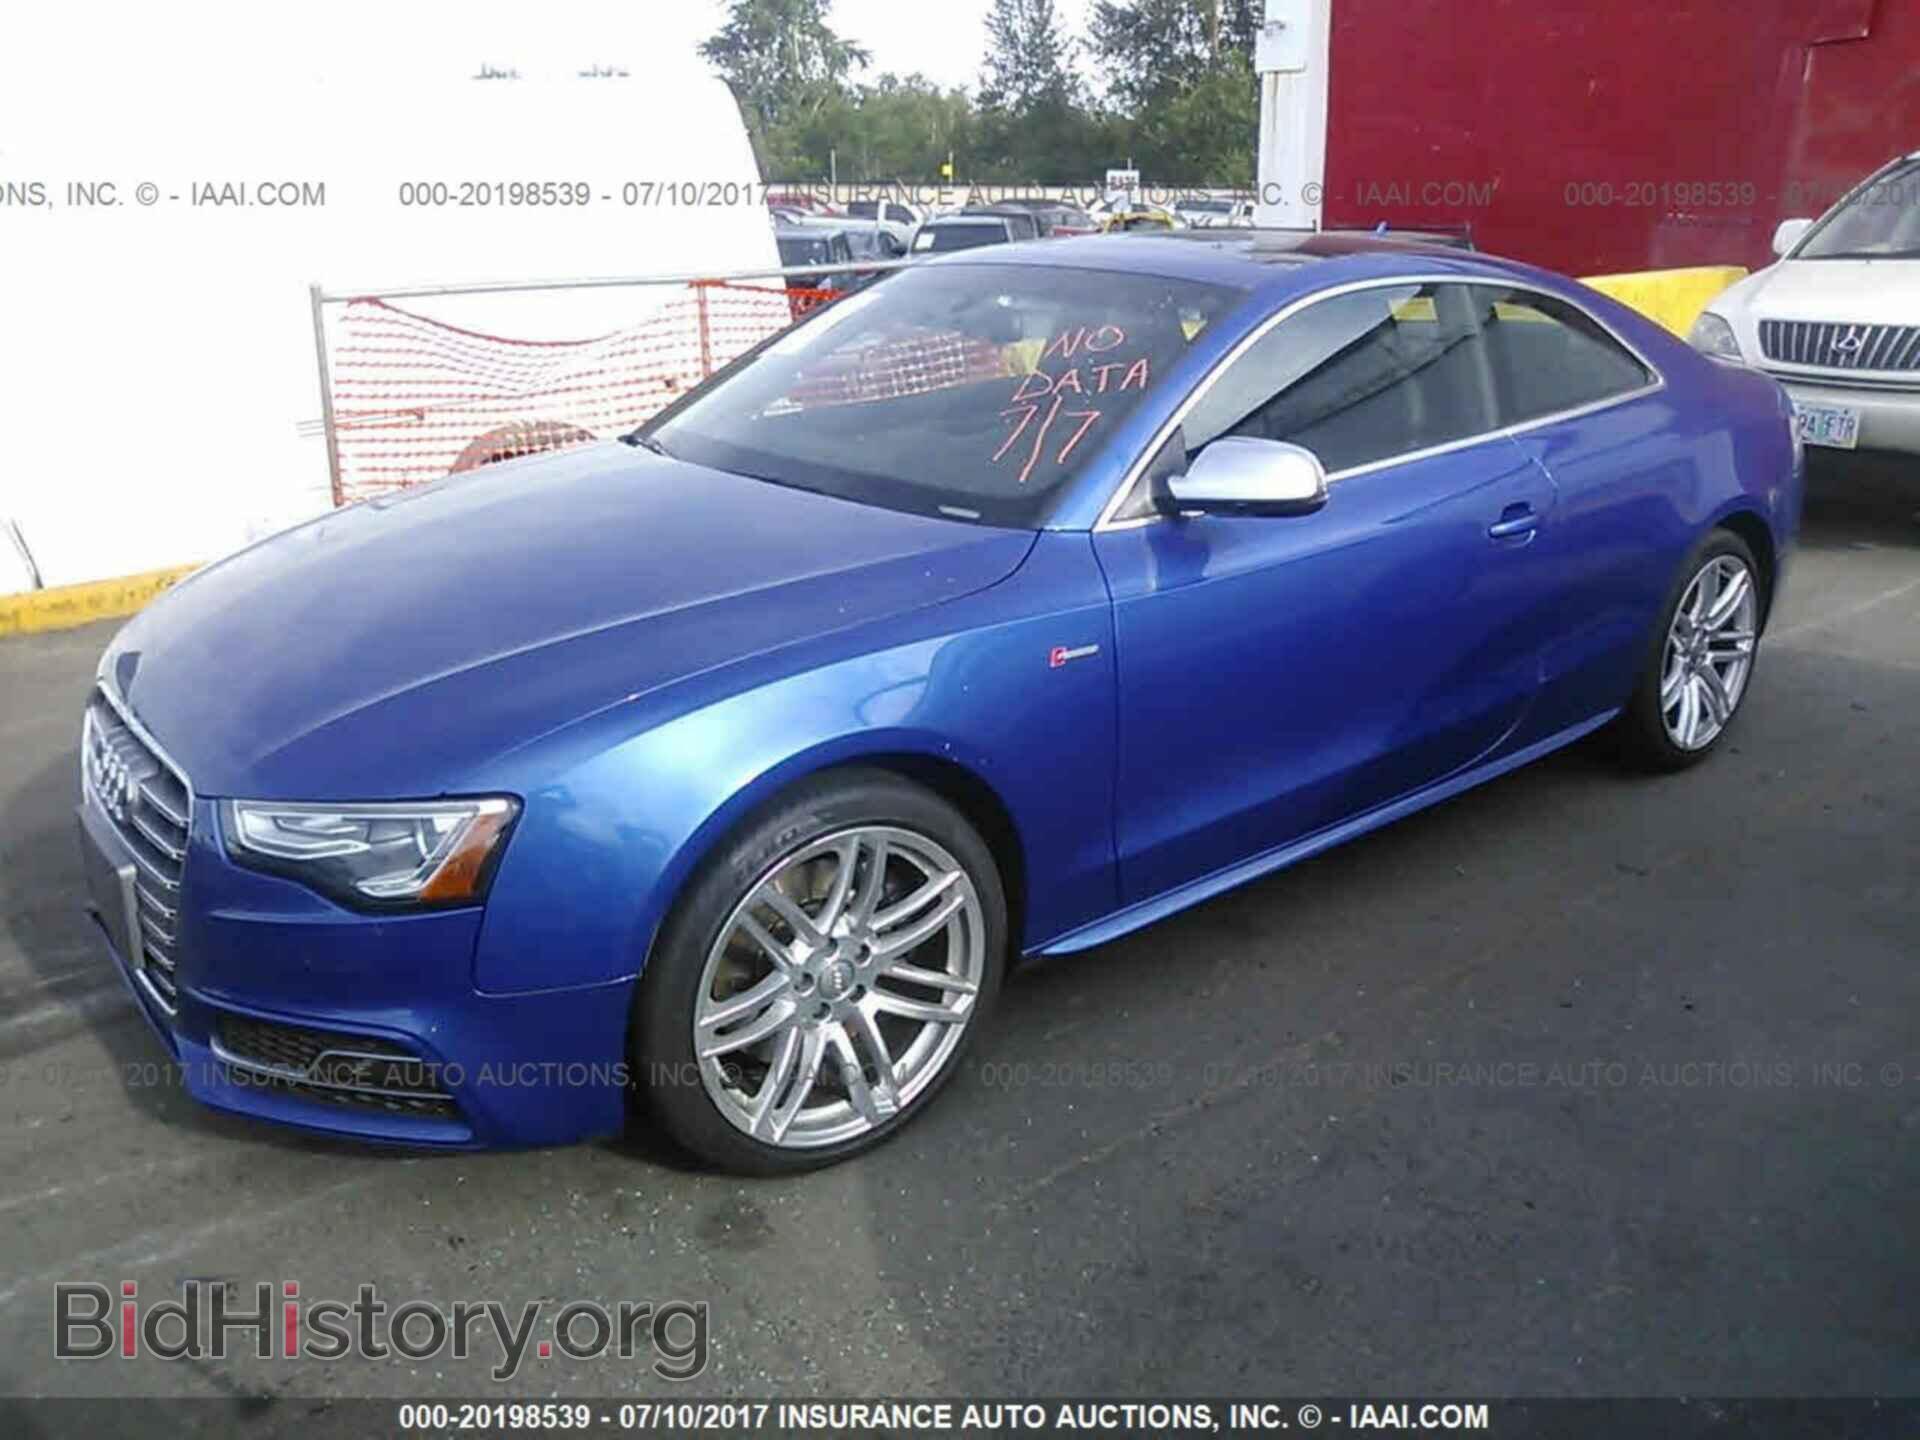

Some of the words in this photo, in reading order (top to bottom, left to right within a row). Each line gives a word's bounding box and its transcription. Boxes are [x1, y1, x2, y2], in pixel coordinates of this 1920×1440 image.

[1044, 324, 1125, 357] NO
[1011, 357, 1150, 402] DATA
[992, 394, 1101, 483] 7/7
